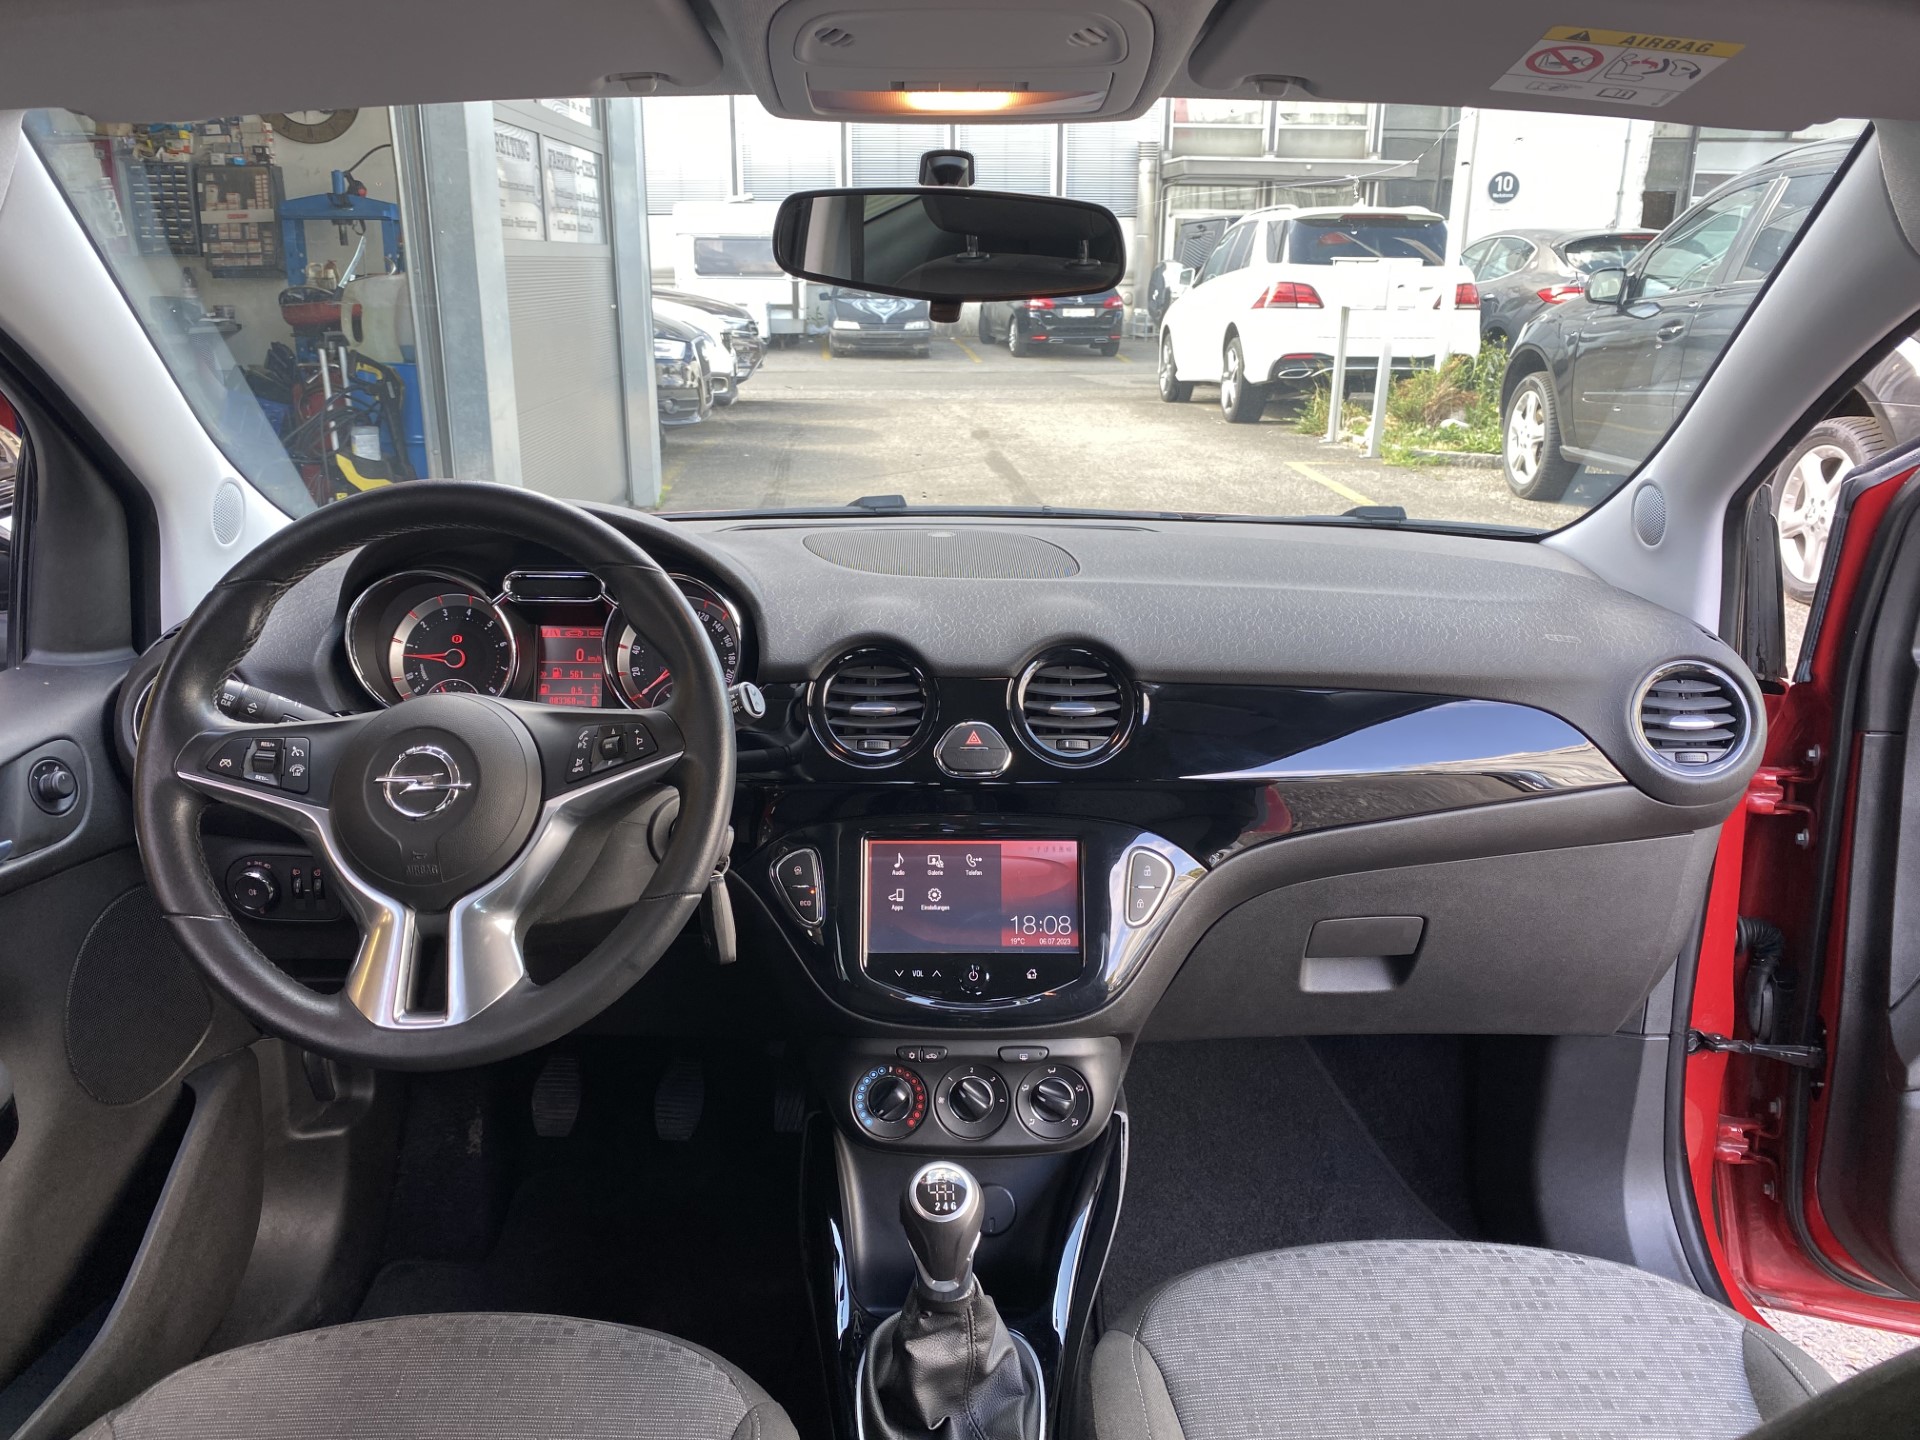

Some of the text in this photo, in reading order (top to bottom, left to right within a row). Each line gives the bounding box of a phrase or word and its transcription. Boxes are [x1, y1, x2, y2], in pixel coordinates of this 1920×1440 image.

[1619, 35, 1714, 54] AIRBAG
[1494, 175, 1514, 192] 10
[442, 608, 448, 617] 3
[466, 608, 472, 616] 4
[420, 621, 427, 629] 2
[487, 620, 495, 628] 5
[713, 620, 724, 632] 140
[723, 634, 733, 648] 160
[631, 645, 641, 655] 40
[576, 648, 585, 662] 0
[727, 652, 736, 665] 180
[570, 670, 584, 679] 561
[631, 666, 641, 677] 20
[488, 686, 496, 694] 8
[222, 692, 236, 702] SET/
[220, 699, 232, 707] CLR
[891, 904, 904, 912] Apps
[920, 904, 950, 912] Einstellungen
[1010, 915, 1072, 935] 18:08
[1010, 937, 1026, 945] 19°C
[912, 969, 925, 977] VOL
[934, 1201, 957, 1211] 2 4 6
